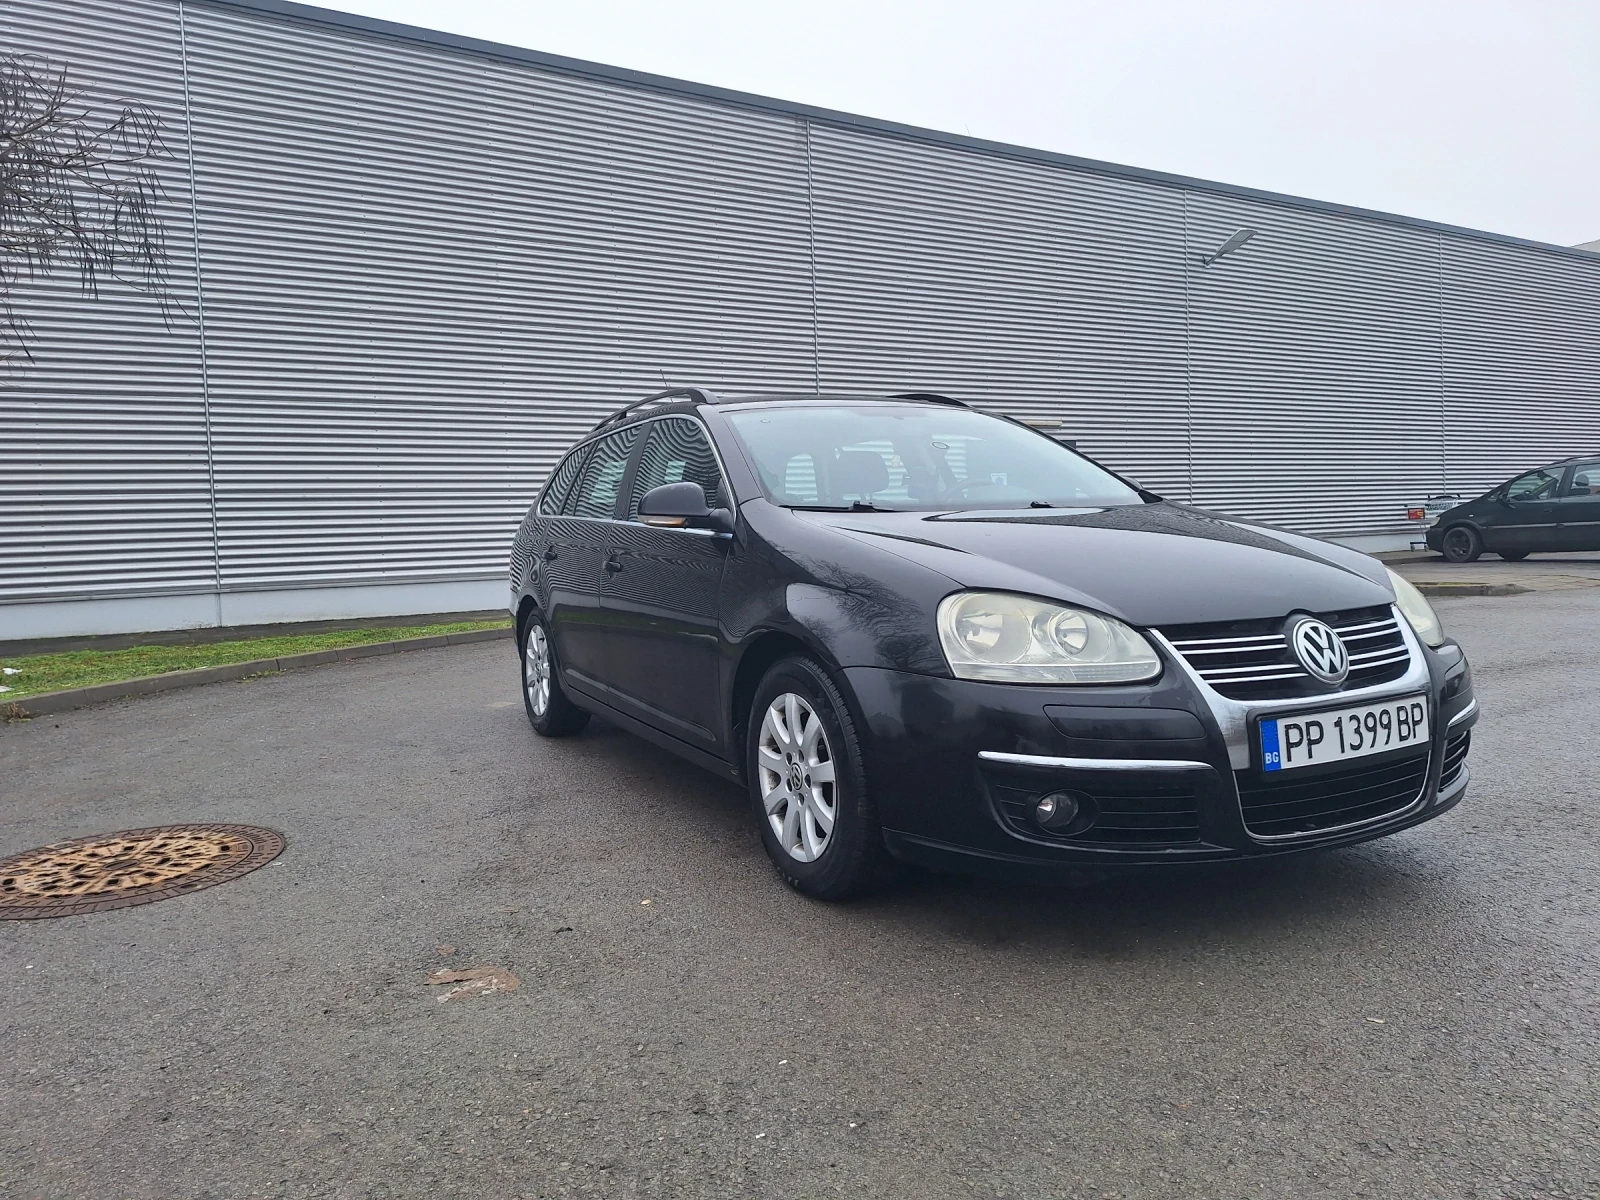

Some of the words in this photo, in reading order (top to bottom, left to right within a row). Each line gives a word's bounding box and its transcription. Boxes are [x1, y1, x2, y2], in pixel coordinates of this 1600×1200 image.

[1299, 623, 1348, 678] VW
[1265, 751, 1280, 764] BG
[1284, 720, 1324, 762] PP
[1333, 709, 1391, 754] 1399
[1396, 702, 1424, 742] BP
